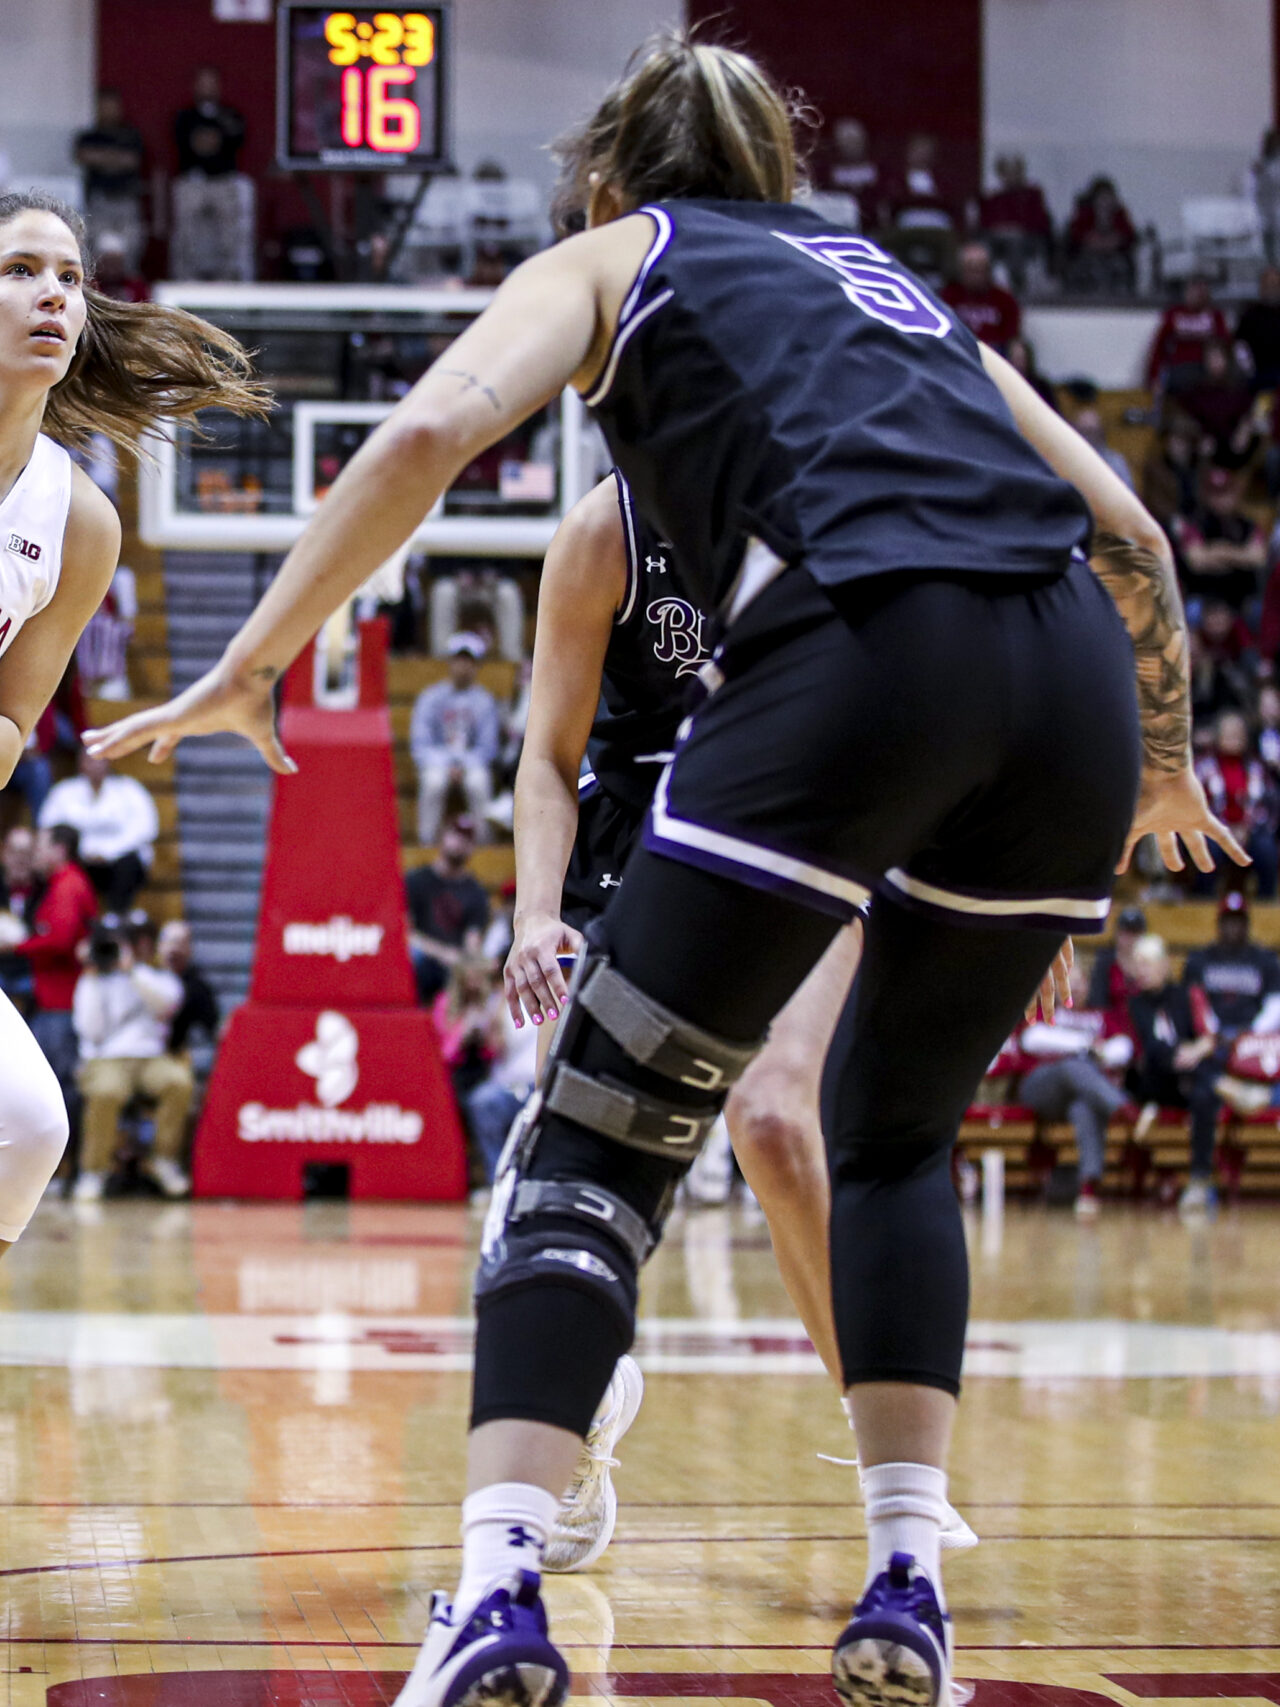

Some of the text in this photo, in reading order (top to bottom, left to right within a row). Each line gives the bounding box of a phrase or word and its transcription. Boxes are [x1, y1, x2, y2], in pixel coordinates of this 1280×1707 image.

[324, 12, 435, 66] 5:23
[341, 64, 421, 153] 16
[770, 230, 952, 338] 5
